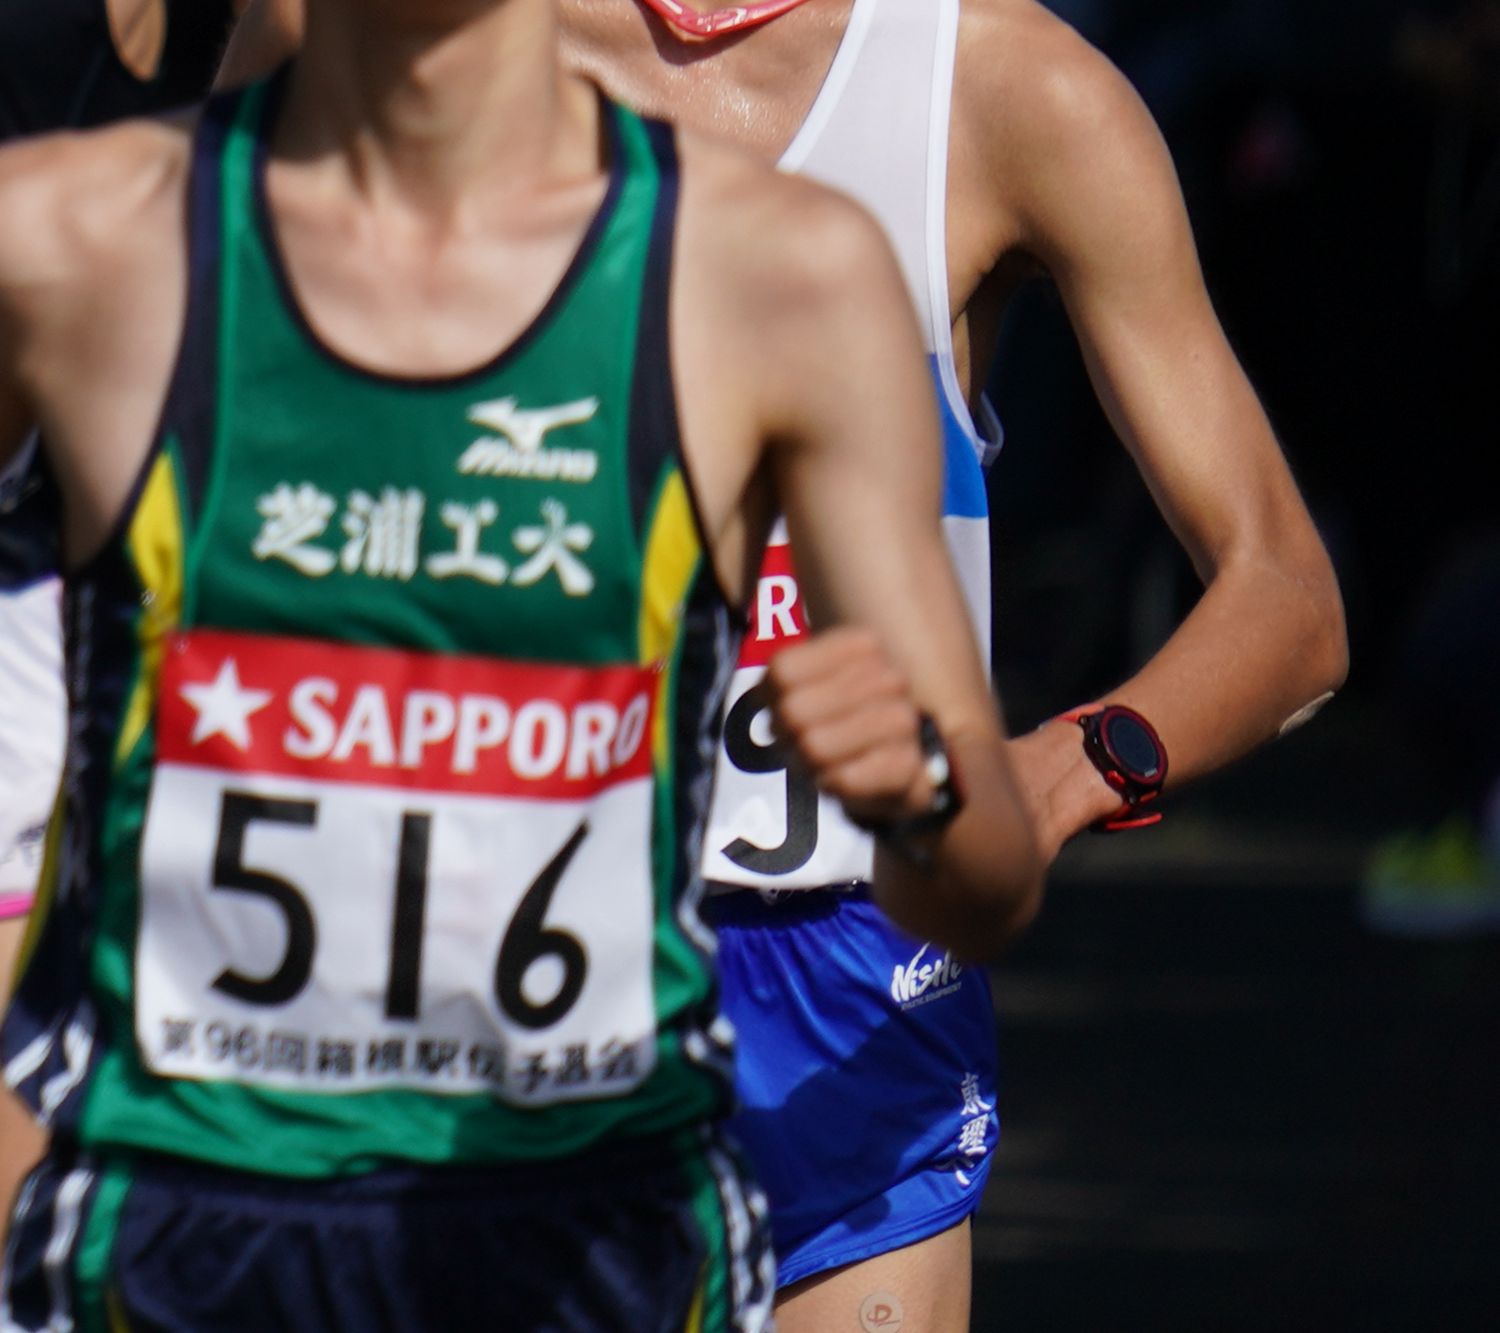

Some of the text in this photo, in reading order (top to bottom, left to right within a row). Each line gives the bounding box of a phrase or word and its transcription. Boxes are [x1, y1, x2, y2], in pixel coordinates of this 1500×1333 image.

[251, 480, 596, 597] 芝浦工大
[283, 675, 651, 781] SAPPORO
[208, 788, 592, 1030] 516
